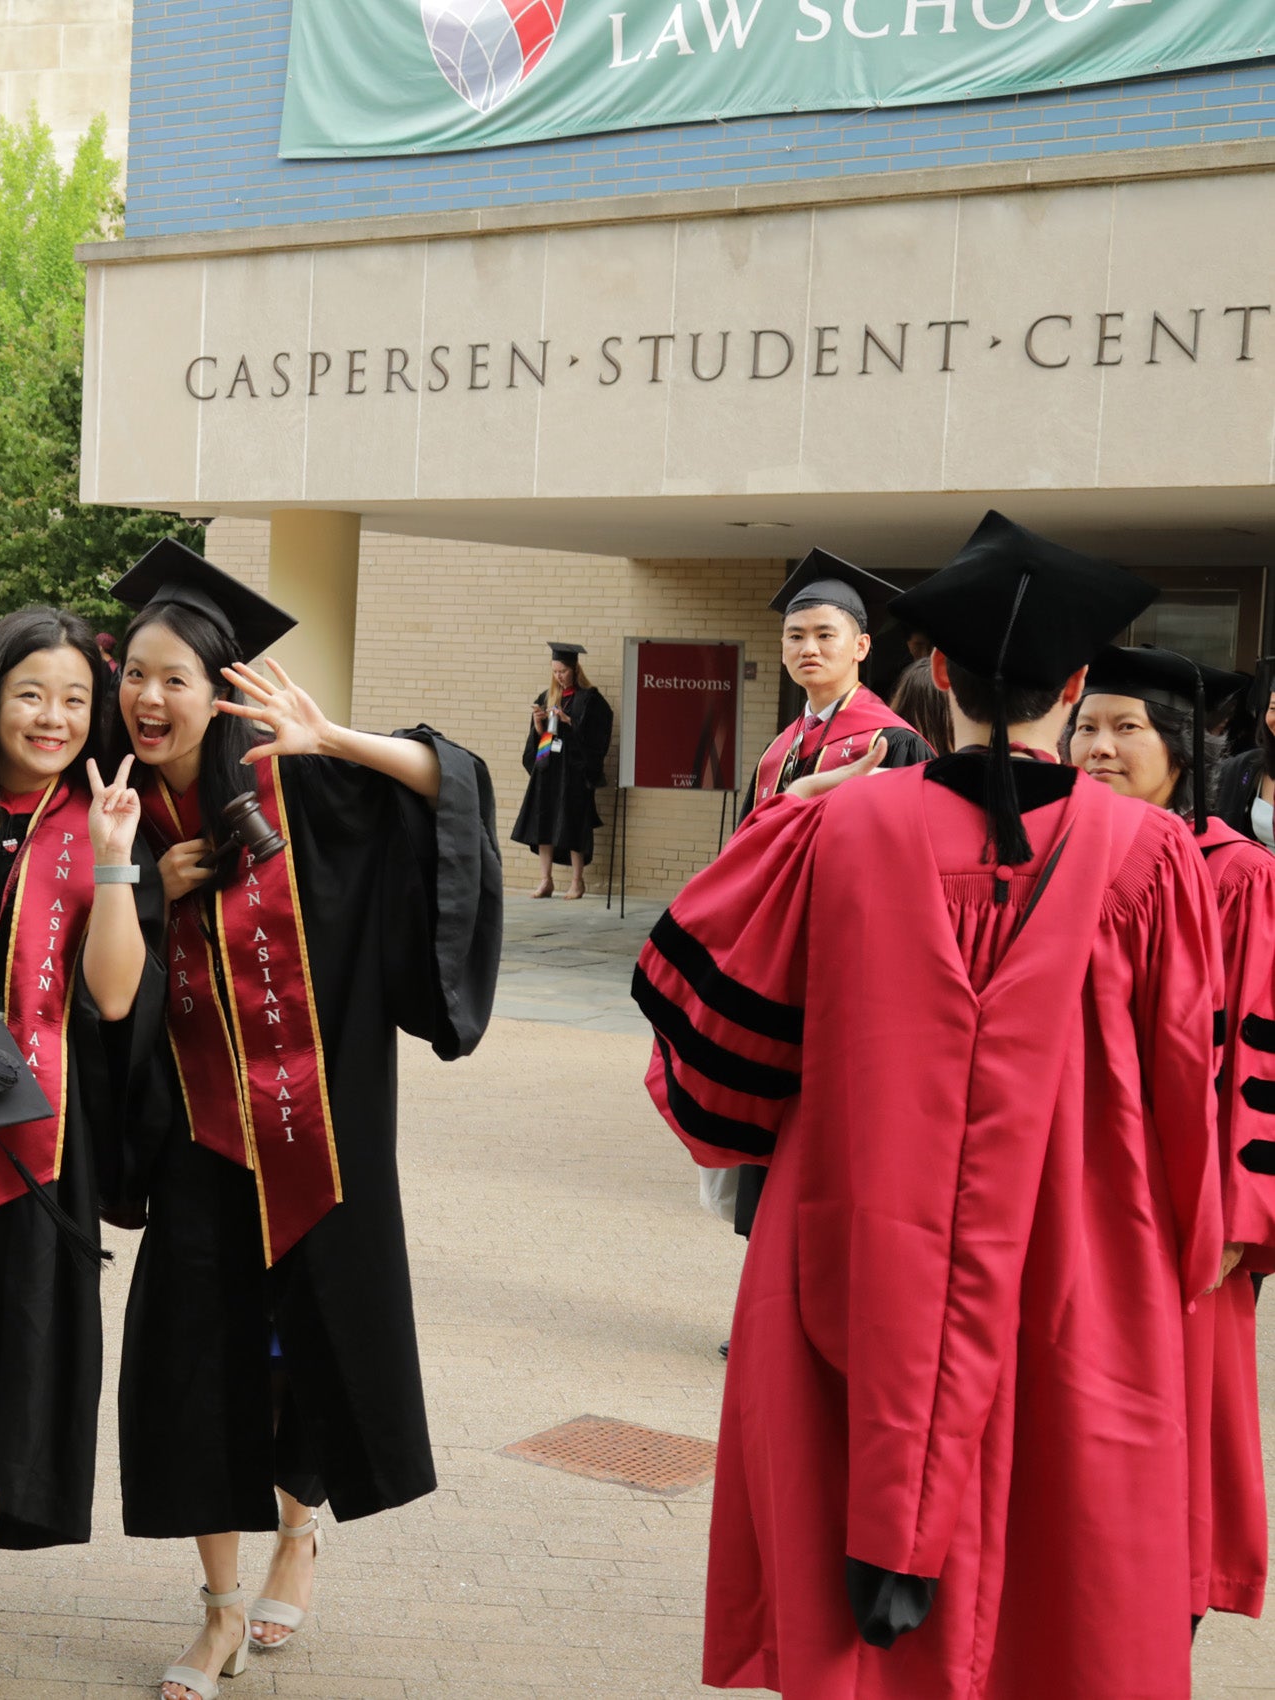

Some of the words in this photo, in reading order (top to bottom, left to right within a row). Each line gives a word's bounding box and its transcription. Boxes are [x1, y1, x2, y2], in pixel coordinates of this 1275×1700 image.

[609, 0, 763, 68] LAW
[185, 340, 551, 401] CASPERSEN
[598, 319, 969, 386] STUDENT
[1024, 304, 1272, 369] CENT
[643, 673, 732, 691] Restrooms
[673, 779, 695, 787] LAW
[55, 832, 74, 880] PAN
[171, 902, 194, 1014] VARD
[245, 853, 261, 907] PAN
[275, 1065, 295, 1143] AAPI
[27, 1031, 41, 1078] AA
